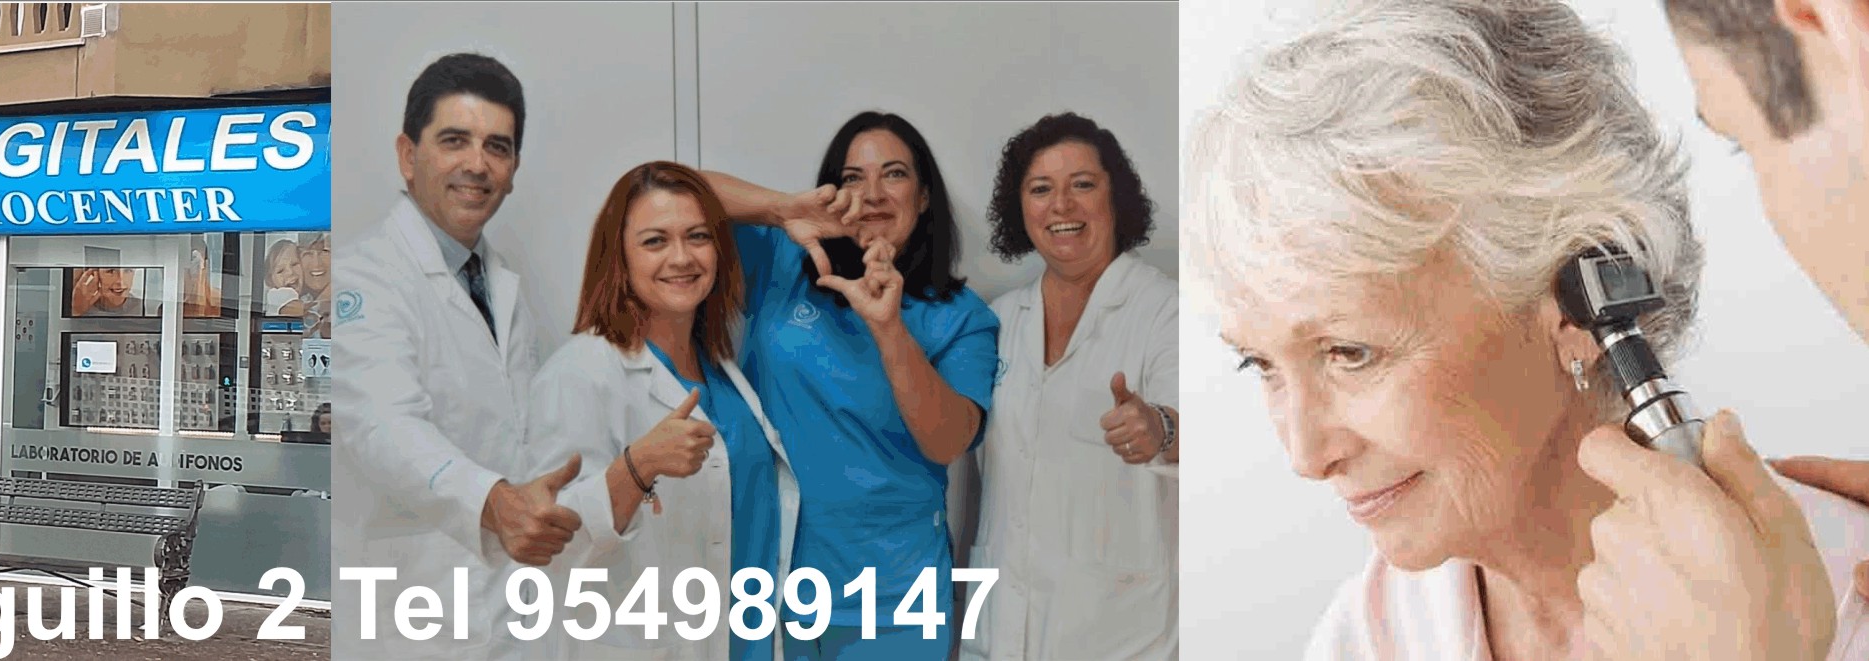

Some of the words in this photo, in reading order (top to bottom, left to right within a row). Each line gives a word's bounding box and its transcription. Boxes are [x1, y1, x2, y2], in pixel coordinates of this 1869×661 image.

[11, 444, 118, 464] LABORATORIO
[123, 450, 141, 466] DE
[147, 452, 243, 472] AIFONOS
